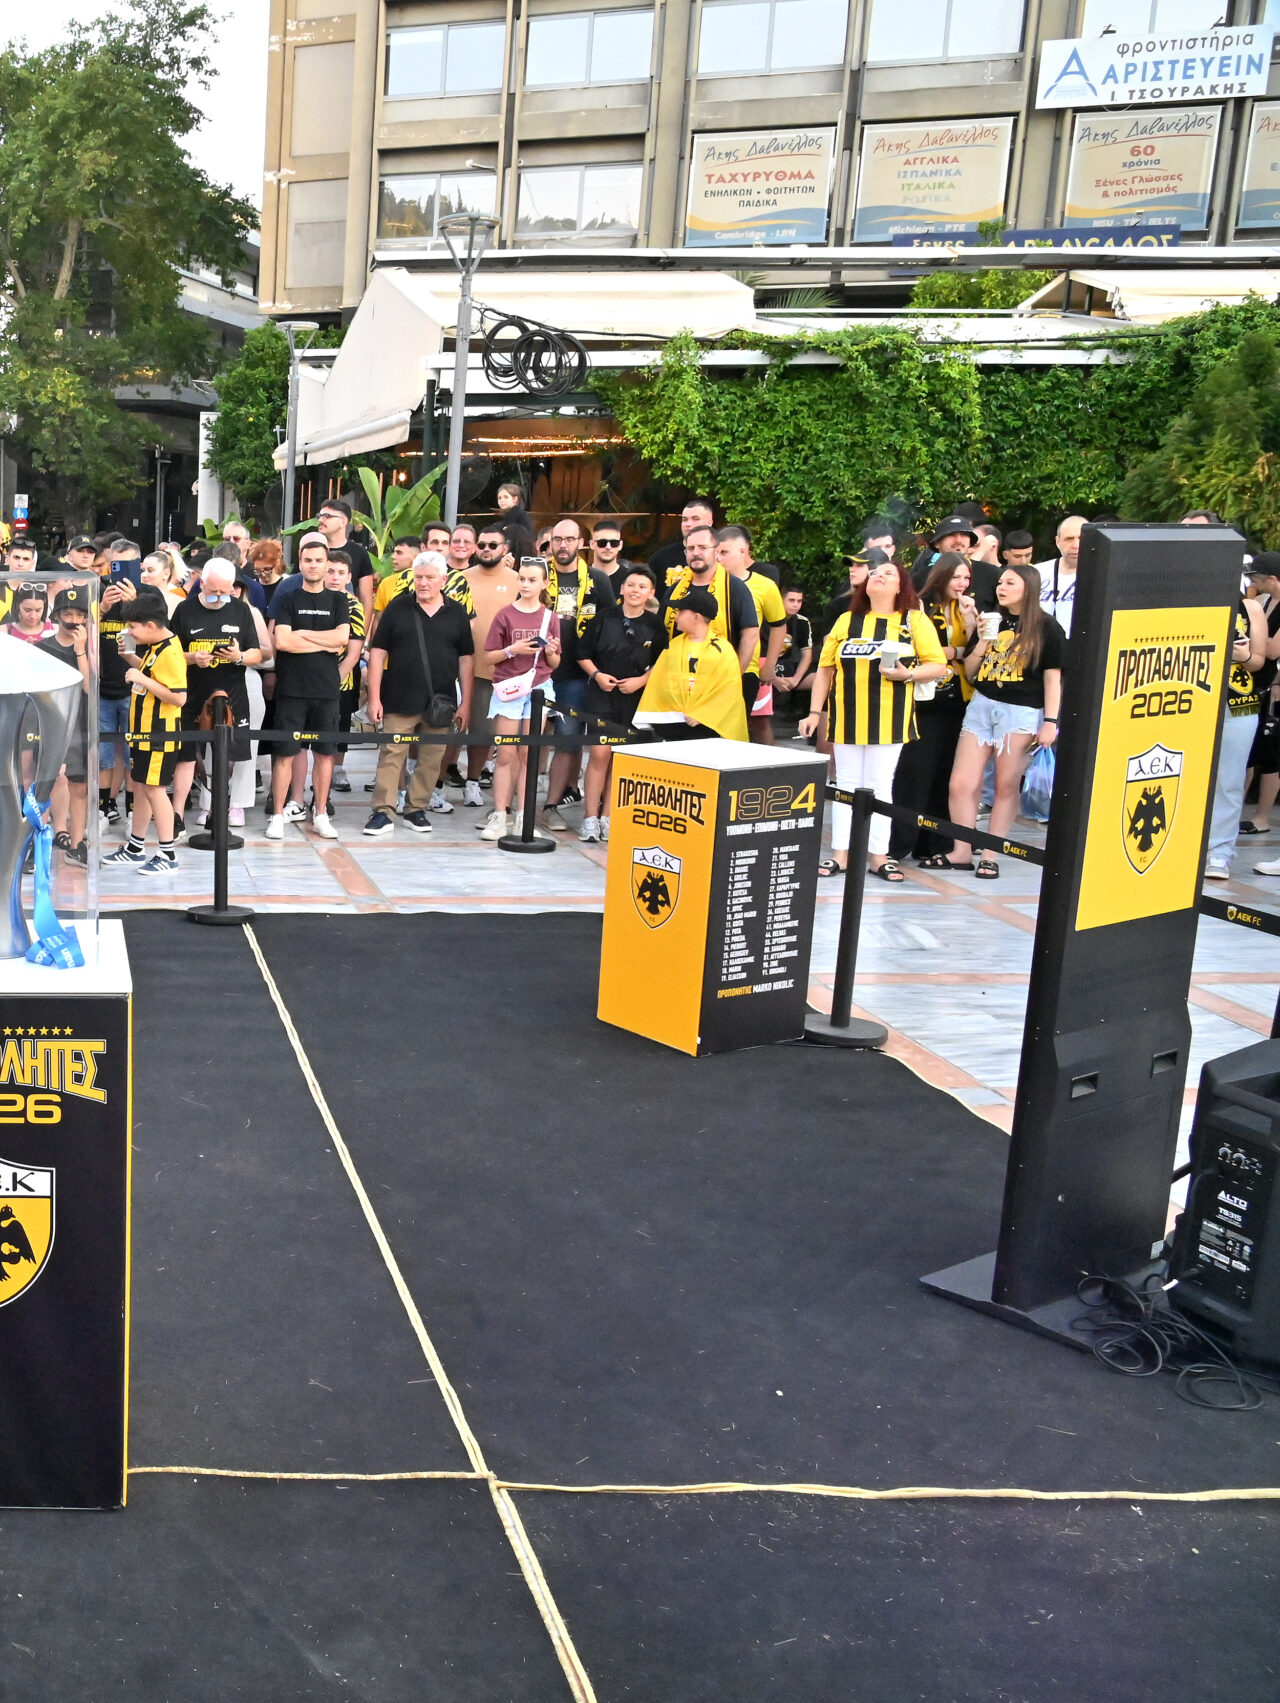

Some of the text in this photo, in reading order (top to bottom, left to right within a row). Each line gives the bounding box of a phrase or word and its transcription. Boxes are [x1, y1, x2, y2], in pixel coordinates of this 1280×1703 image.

[1117, 31, 1253, 58] φροντιστήρια
[1101, 53, 1264, 85] ΑΡΙΣΤΕΥΕΙΝ
[1128, 82, 1247, 100] ΤΣΟΥΡΑΚΗΣ
[1130, 145, 1156, 157] 60
[903, 155, 960, 166] ΑΓΓΛΙΚΑ
[1122, 158, 1161, 169] χρόνια
[705, 169, 816, 184] ΤΑΧΥΡΥΘΜΑ
[896, 169, 962, 179] ΙΣΠΑΝΙΚΑ
[1094, 173, 1183, 188] Ξένες Γλώσσες
[704, 186, 816, 198] ΕΝΗΛΙΚΩΝ ΦΟΙΤΗΤΩΝ
[901, 181, 956, 192] ΙΤΑΛΙΚΑ
[1101, 184, 1179, 199] & πολιτισμός
[738, 199, 778, 208] ΠΑΙΔΙΚΑ
[714, 229, 767, 240] Cambridge
[1112, 643, 1217, 702] ΠΡΩΤΑΘΛΗΤΕΣ
[1130, 689, 1193, 719] 2026
[617, 777, 707, 827] ΠΡΩΤΑΘΛΗΤΕΣ
[729, 783, 817, 821] 1924
[632, 808, 687, 835] 2026
[1009, 845, 1021, 855] AEK
[1236, 912, 1263, 926] AEK FC
[1217, 1190, 1248, 1210] ALTO
